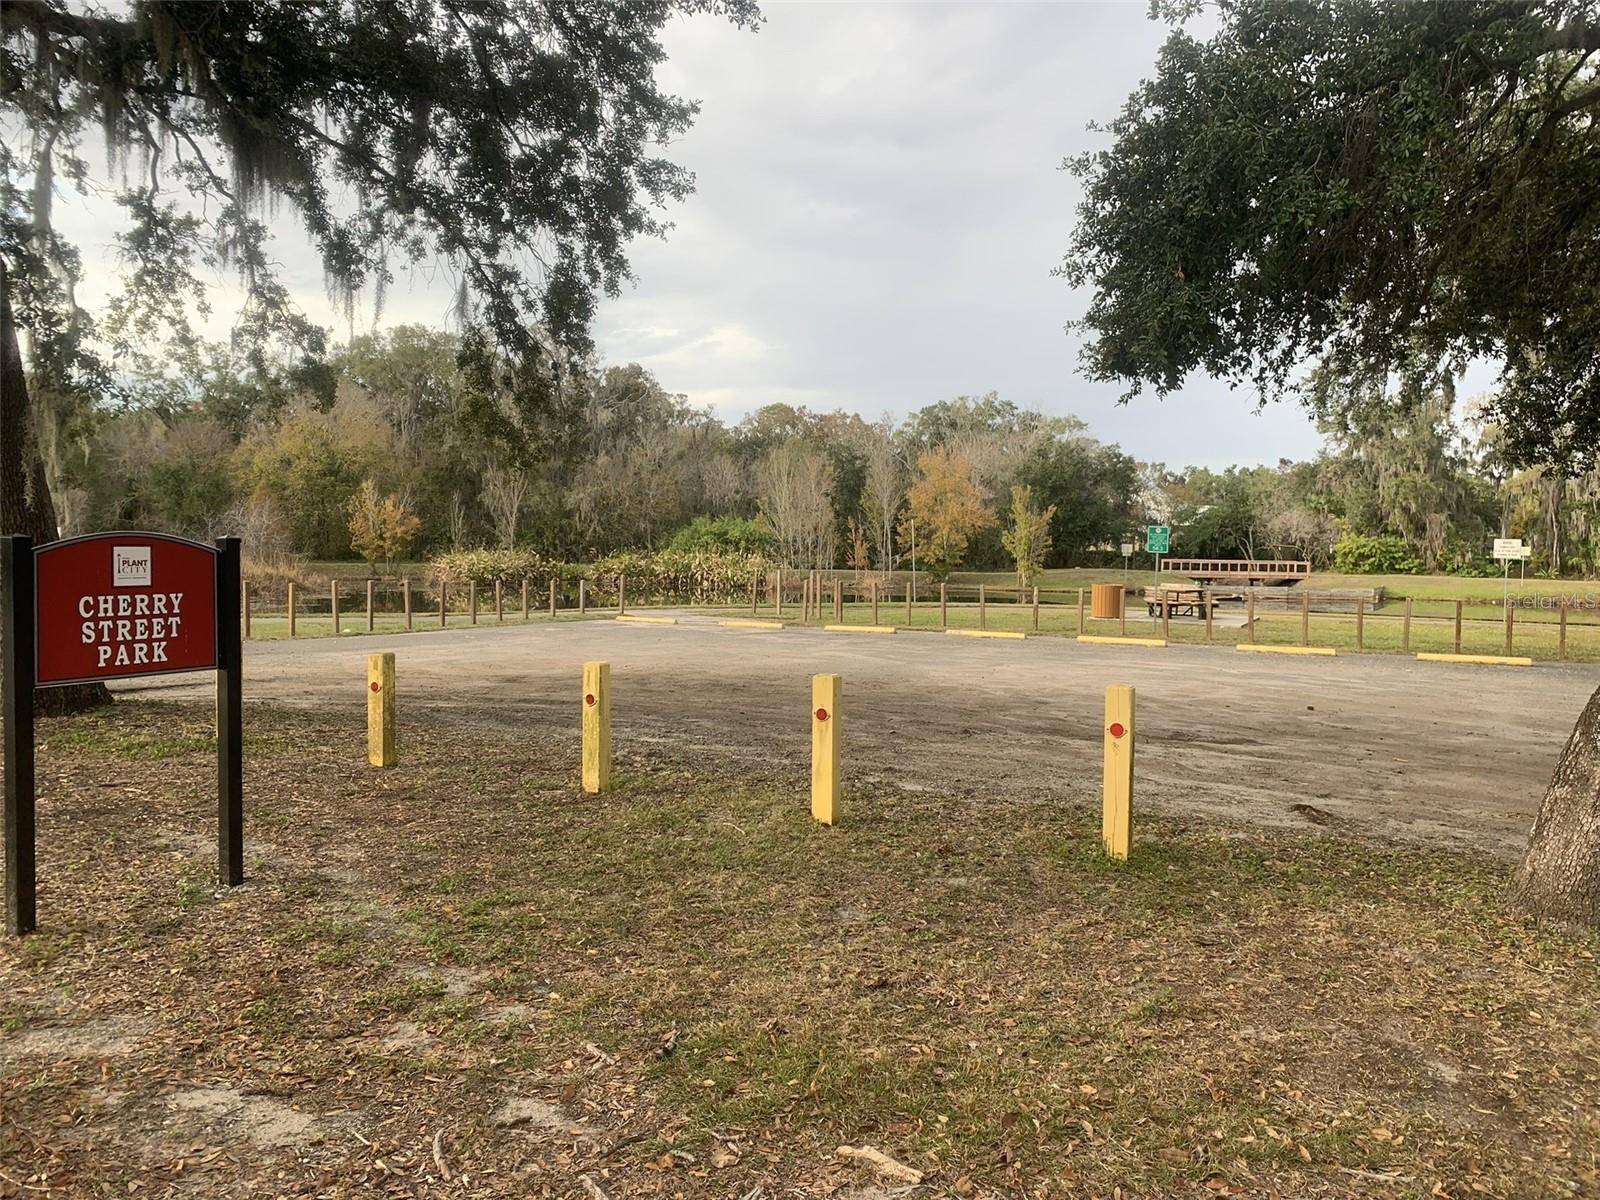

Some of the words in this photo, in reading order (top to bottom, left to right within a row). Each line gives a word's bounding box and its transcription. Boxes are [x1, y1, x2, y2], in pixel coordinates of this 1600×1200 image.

[122, 559, 148, 567] PLANT
[122, 566, 148, 574] CITY
[78, 593, 183, 618] CHERRY
[81, 616, 181, 644] STREET
[97, 641, 168, 667] PARK
